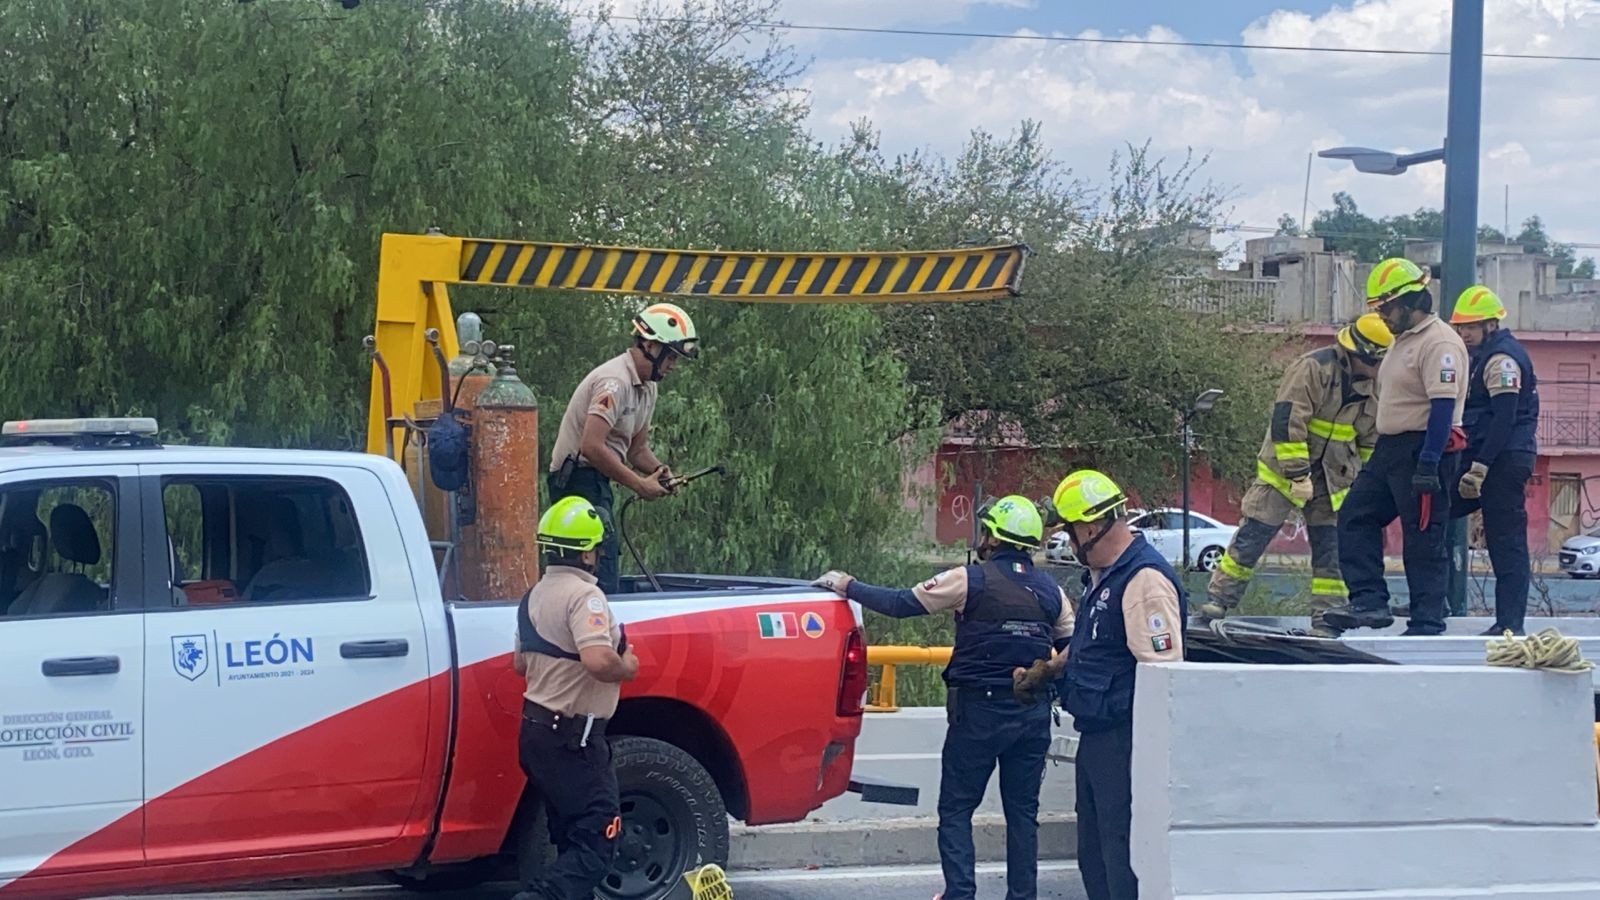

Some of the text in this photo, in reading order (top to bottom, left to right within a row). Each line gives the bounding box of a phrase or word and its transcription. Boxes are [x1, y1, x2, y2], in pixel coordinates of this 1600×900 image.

[225, 632, 314, 668] LEÓN
[228, 671, 280, 681] AYUNTAMIENTO
[3, 710, 113, 725] DIRECCIÓN GENERAL
[91, 721, 135, 737] CIVIL
